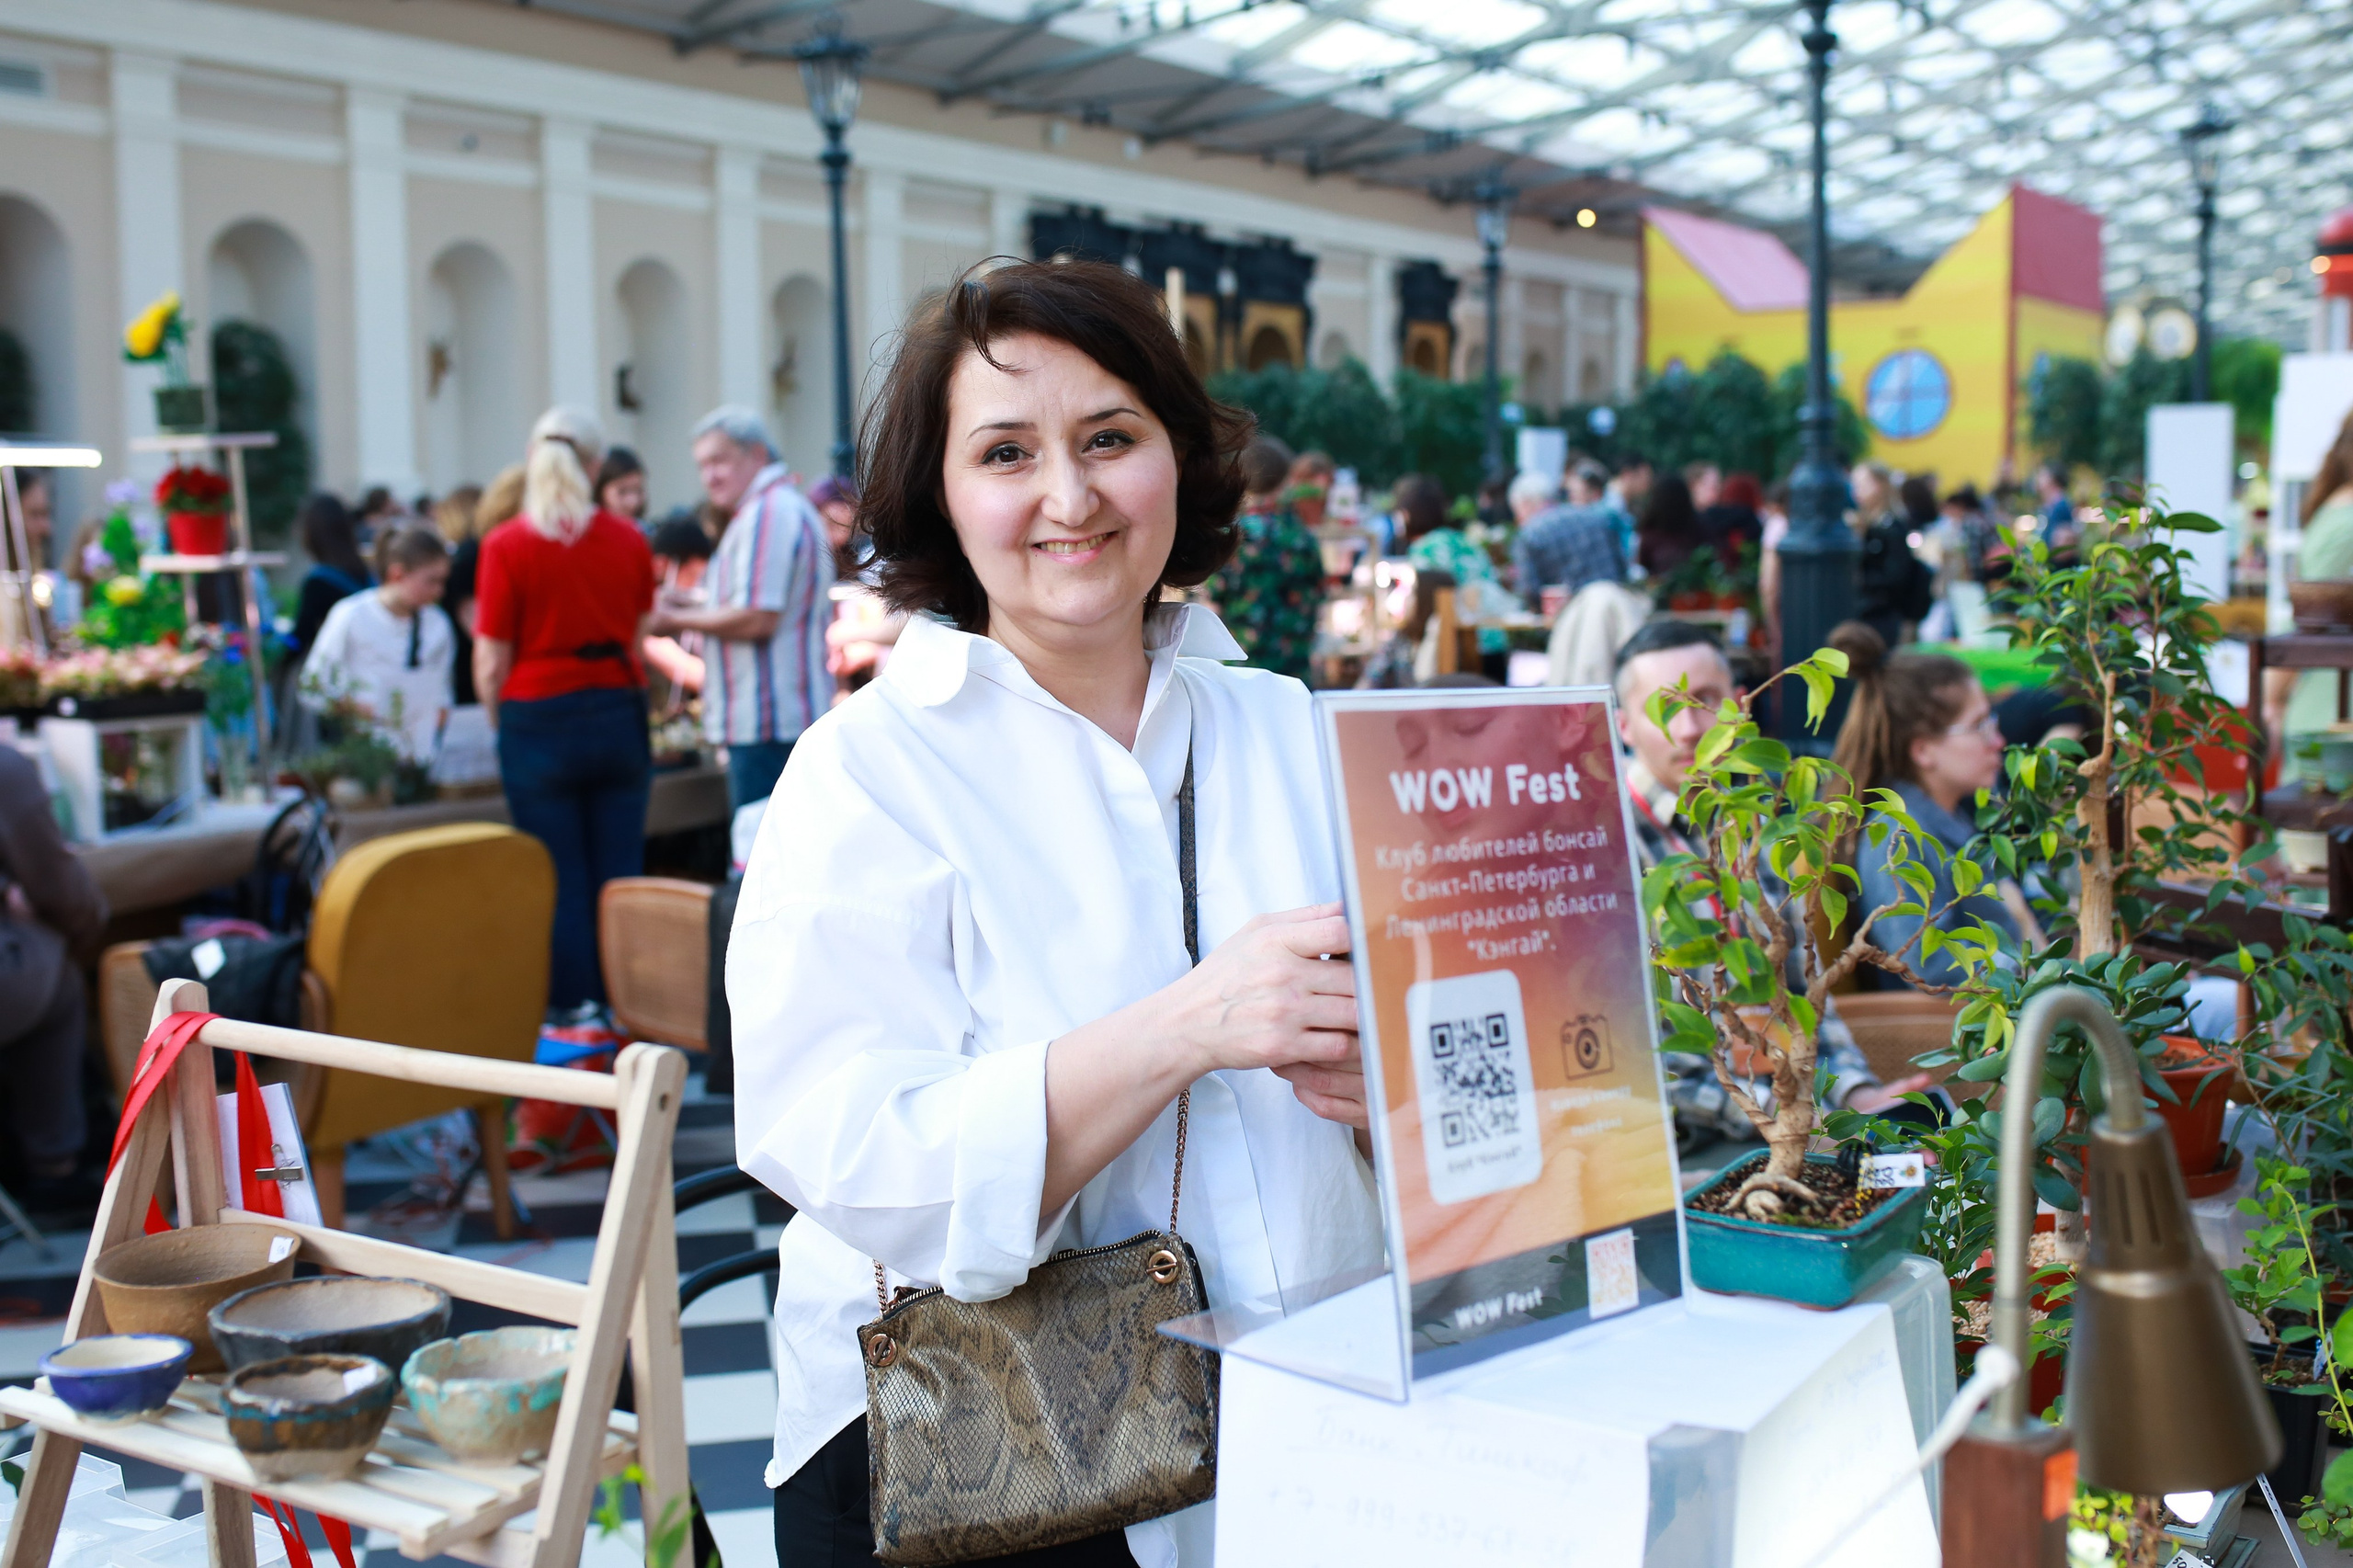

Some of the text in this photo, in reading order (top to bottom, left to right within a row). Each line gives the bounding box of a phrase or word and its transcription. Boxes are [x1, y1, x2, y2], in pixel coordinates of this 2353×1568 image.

[1389, 763, 1582, 813] WOW Fest
[1375, 825, 1608, 873] Клуб любителей бонсай
[1401, 863, 1597, 902] Санкт-Петербурга и
[1544, 892, 1618, 918] области
[1454, 1296, 1504, 1330] WOW
